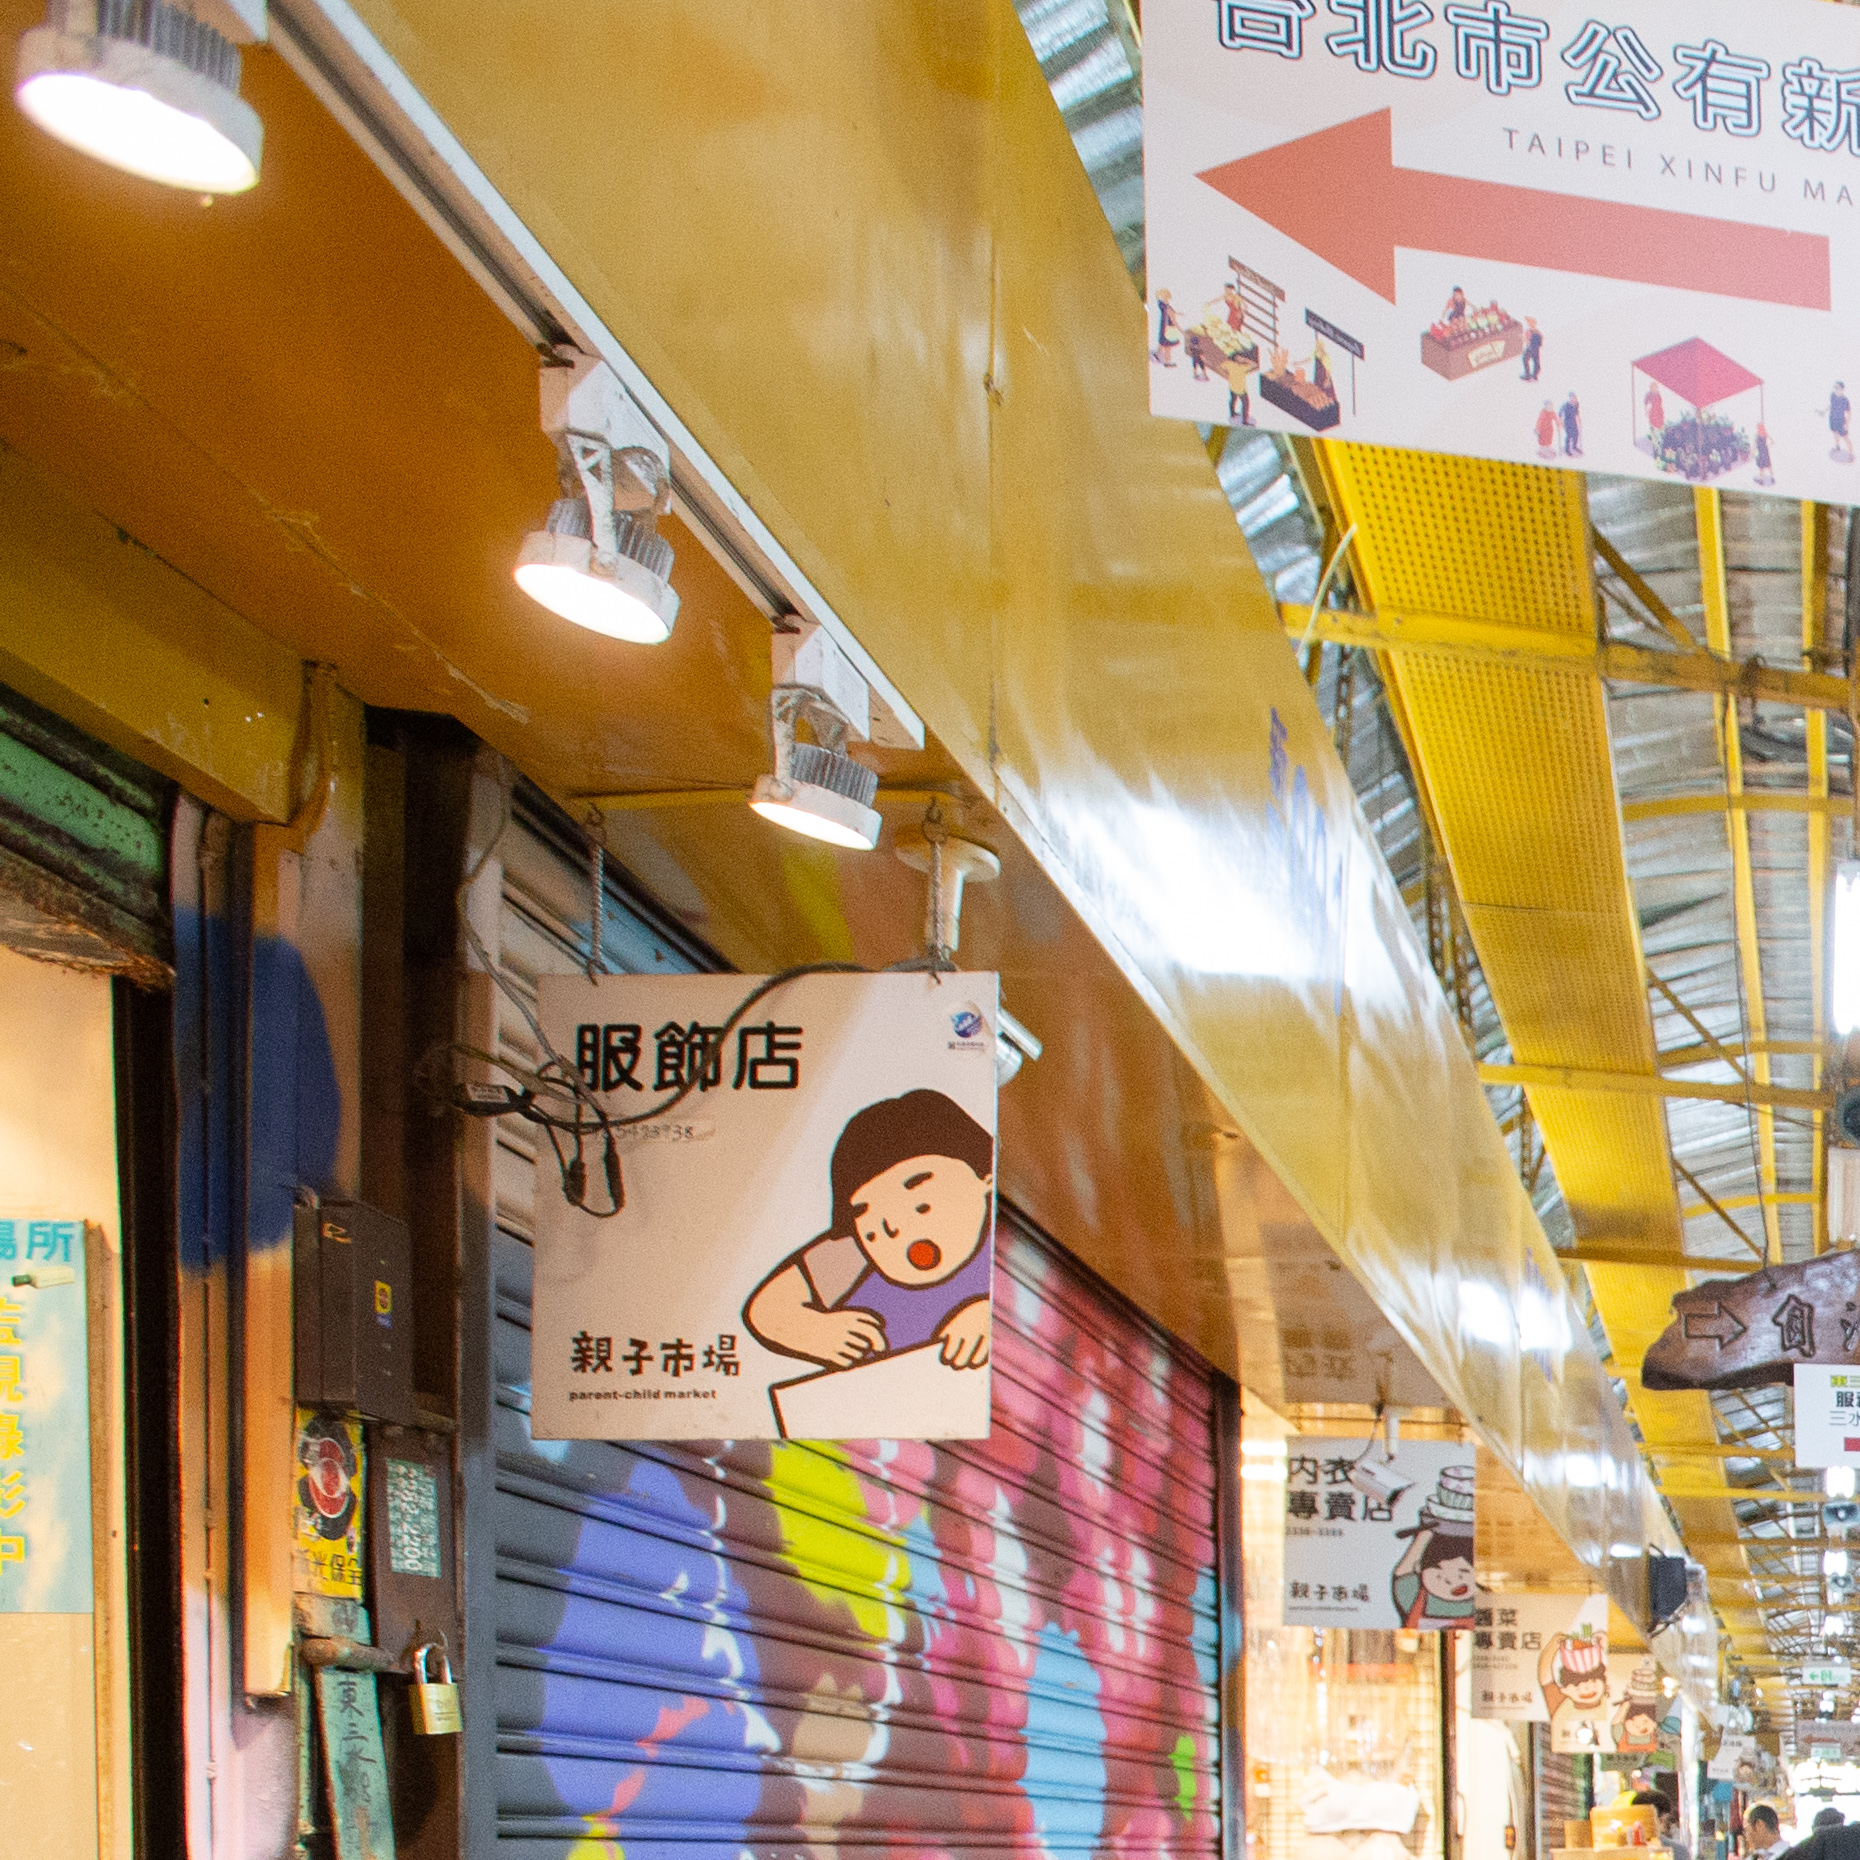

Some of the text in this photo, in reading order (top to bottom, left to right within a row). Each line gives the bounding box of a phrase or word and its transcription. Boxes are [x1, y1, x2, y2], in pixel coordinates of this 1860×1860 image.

[1502, 126, 1634, 169] TAIPEI
[1659, 154, 1776, 192] XINFU
[575, 1021, 804, 1093] 服飾店
[569, 1331, 741, 1378] 親子市場
[568, 1387, 718, 1402] parent-child market
[1288, 1490, 1393, 1521] 專賣店
